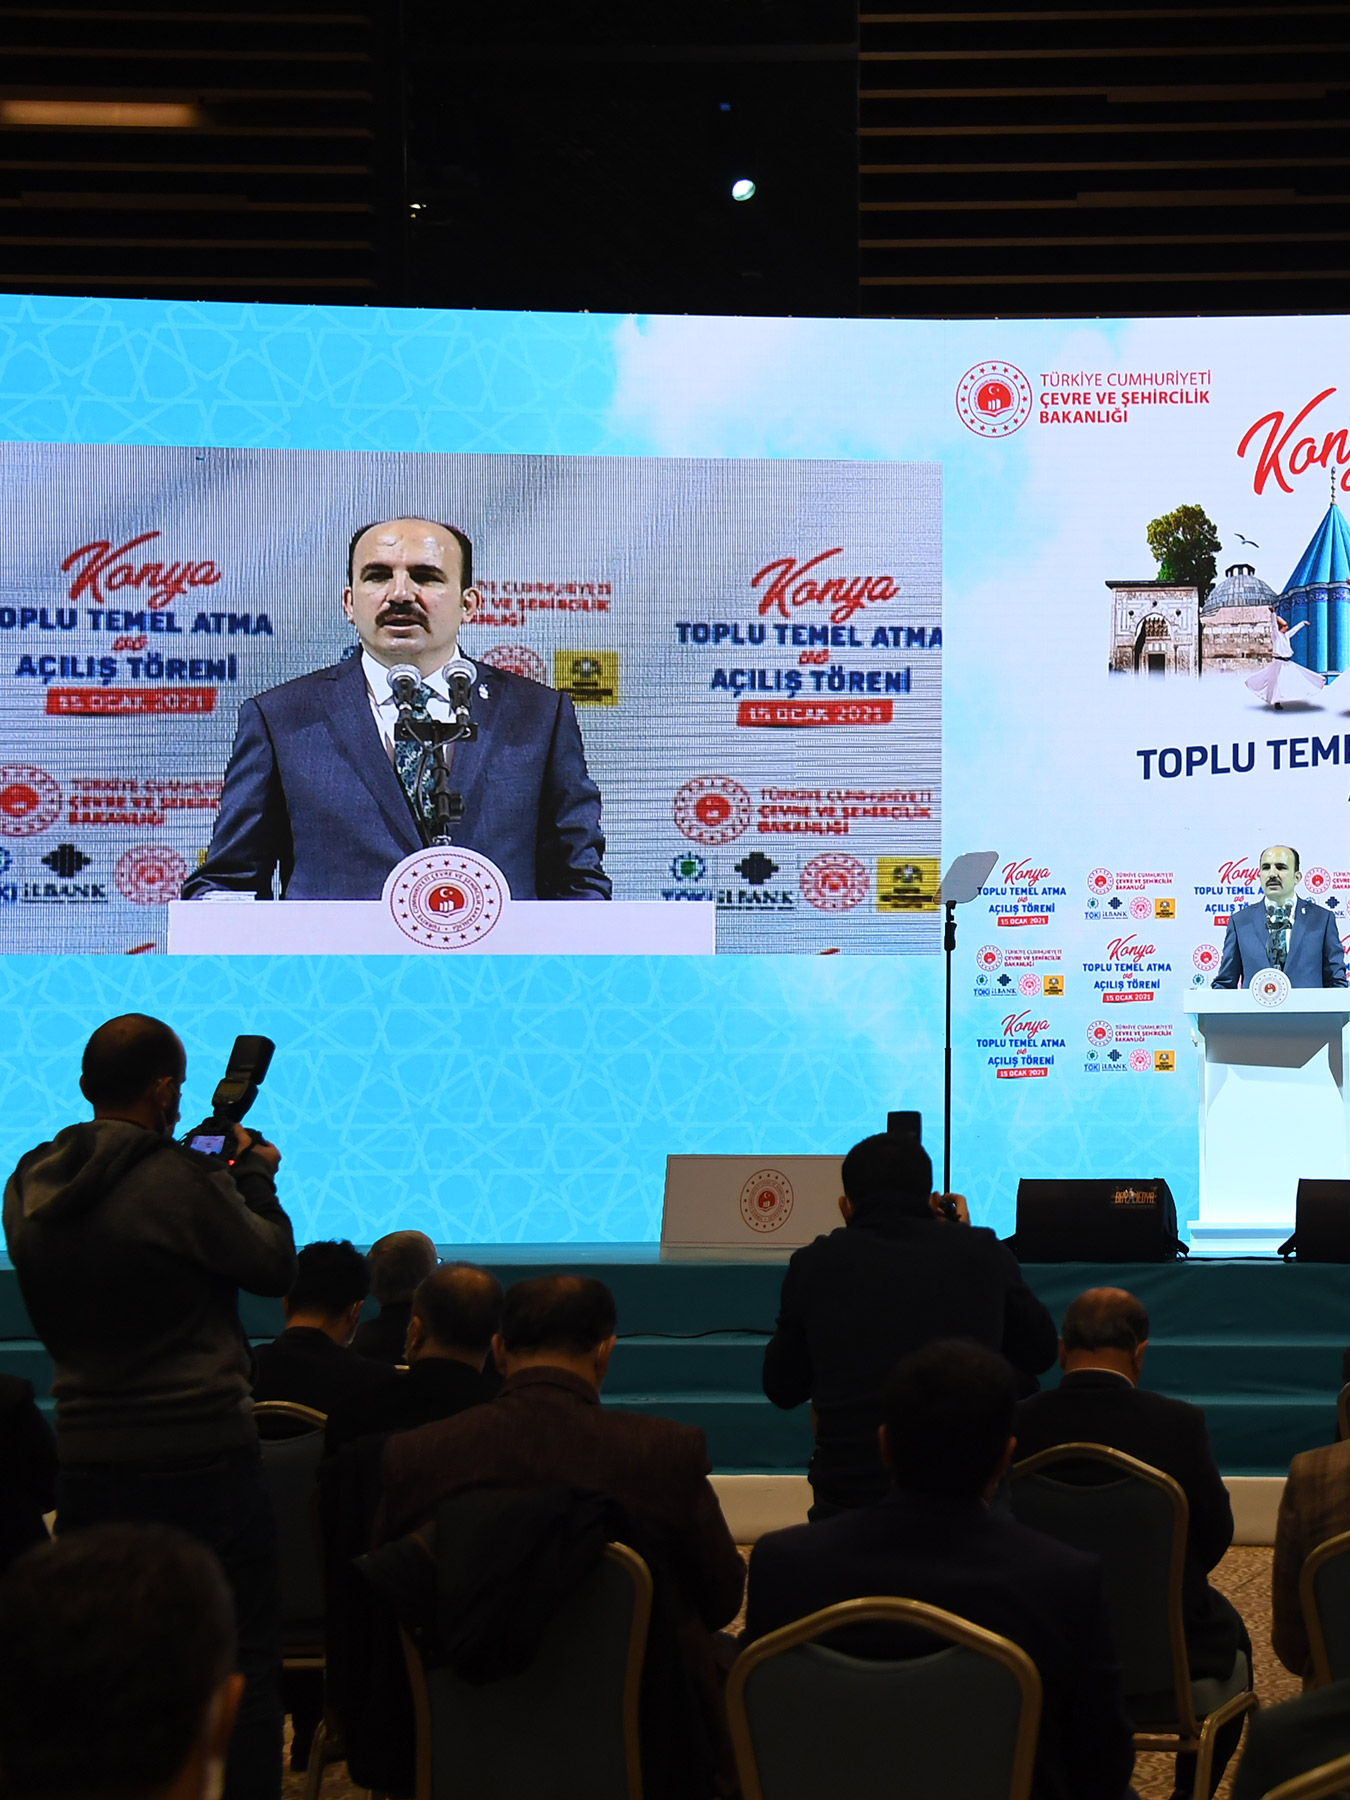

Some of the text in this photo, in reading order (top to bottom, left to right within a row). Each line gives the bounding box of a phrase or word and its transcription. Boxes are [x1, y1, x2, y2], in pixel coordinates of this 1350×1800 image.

[1040, 369, 1212, 387] TÜRKİYE CUMHURİYETİ
[1040, 388, 1210, 408] ÇEVRE VE ŞEHİRCİLİK
[1040, 408, 1128, 424] BAKANLIĞI
[60, 531, 222, 610] Konya
[751, 548, 900, 624] Konya
[0, 608, 274, 635] OPLU TEMEL ATMA
[676, 622, 942, 648] TOPLU TEMEL ATMA
[15, 652, 237, 686] AÇILIŞ TÖRENİ
[712, 666, 911, 698] AÇILIŞ TÖRENİ
[1136, 741, 1256, 780] TOPLU
[1002, 858, 1051, 887] Konya
[977, 887, 1067, 895] TOPLU TEMEL ATMA
[1194, 886, 1224, 895] TOPLU
[1227, 886, 1256, 895] TEMEL
[989, 902, 1055, 915] AÇILIŞ TÖRENİ
[1206, 904, 1236, 914] AÇILIŞ
[1108, 934, 1156, 963] Konya
[1083, 963, 1171, 972] TOPLU TEMEL ATMA
[1094, 978, 1160, 991] AÇILIŞ TÖRENİ
[1002, 1010, 1050, 1039] Konya
[977, 1039, 1065, 1048] TOPLU TEMEL ATMA
[988, 1054, 1054, 1067] AÇILIŞ TÖRENİ
